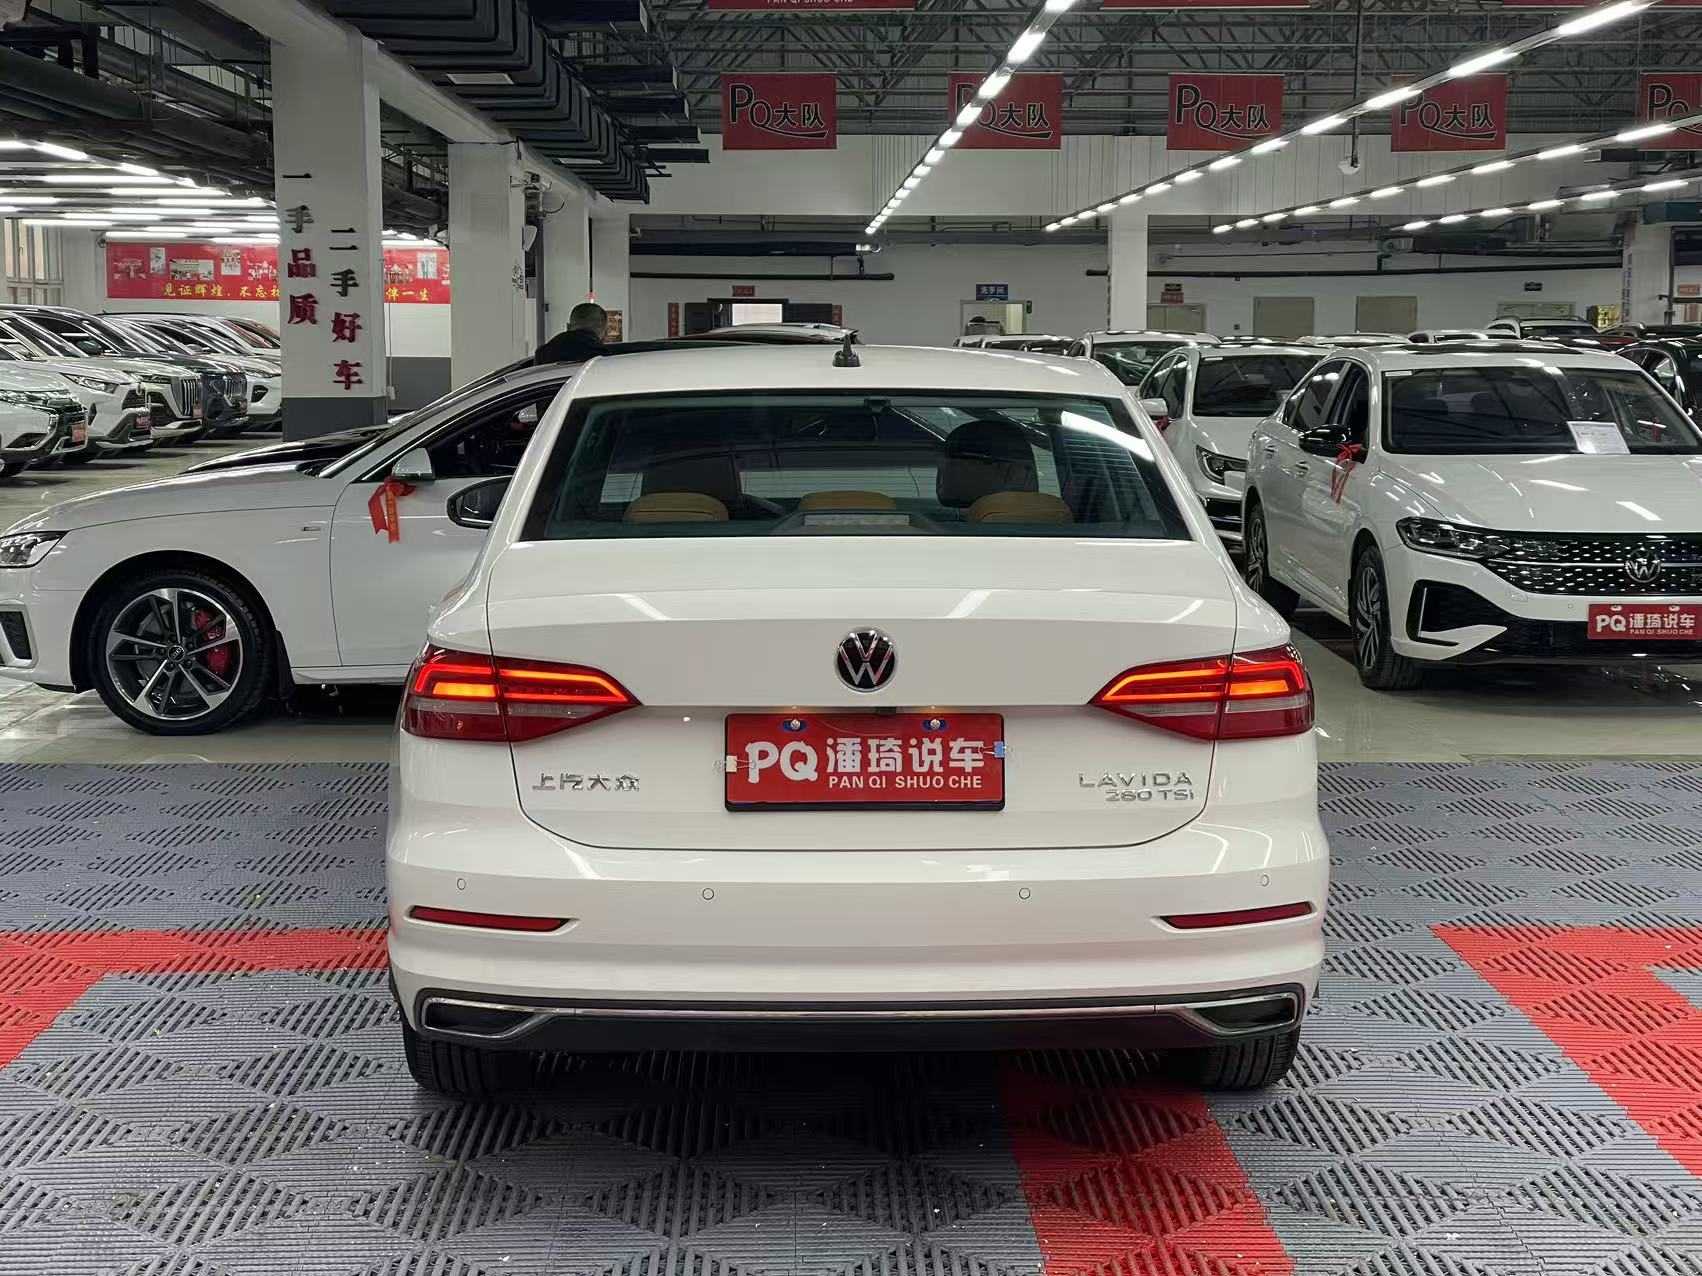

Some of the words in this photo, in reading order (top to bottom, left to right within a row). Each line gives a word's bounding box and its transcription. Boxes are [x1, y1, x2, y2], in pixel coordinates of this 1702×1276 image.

[282, 173, 318, 325] 一手品质
[329, 227, 363, 390] 二手好车
[1595, 614, 1626, 632] PQ
[745, 741, 818, 783] PQ
[826, 737, 985, 773] 潘琦说车
[532, 773, 640, 792] 上汽大众
[829, 776, 864, 789] PAN
[868, 776, 887, 789] QI
[895, 776, 944, 789] SHUO
[948, 776, 982, 789] CHE
[1079, 772, 1193, 787] LAVIDA
